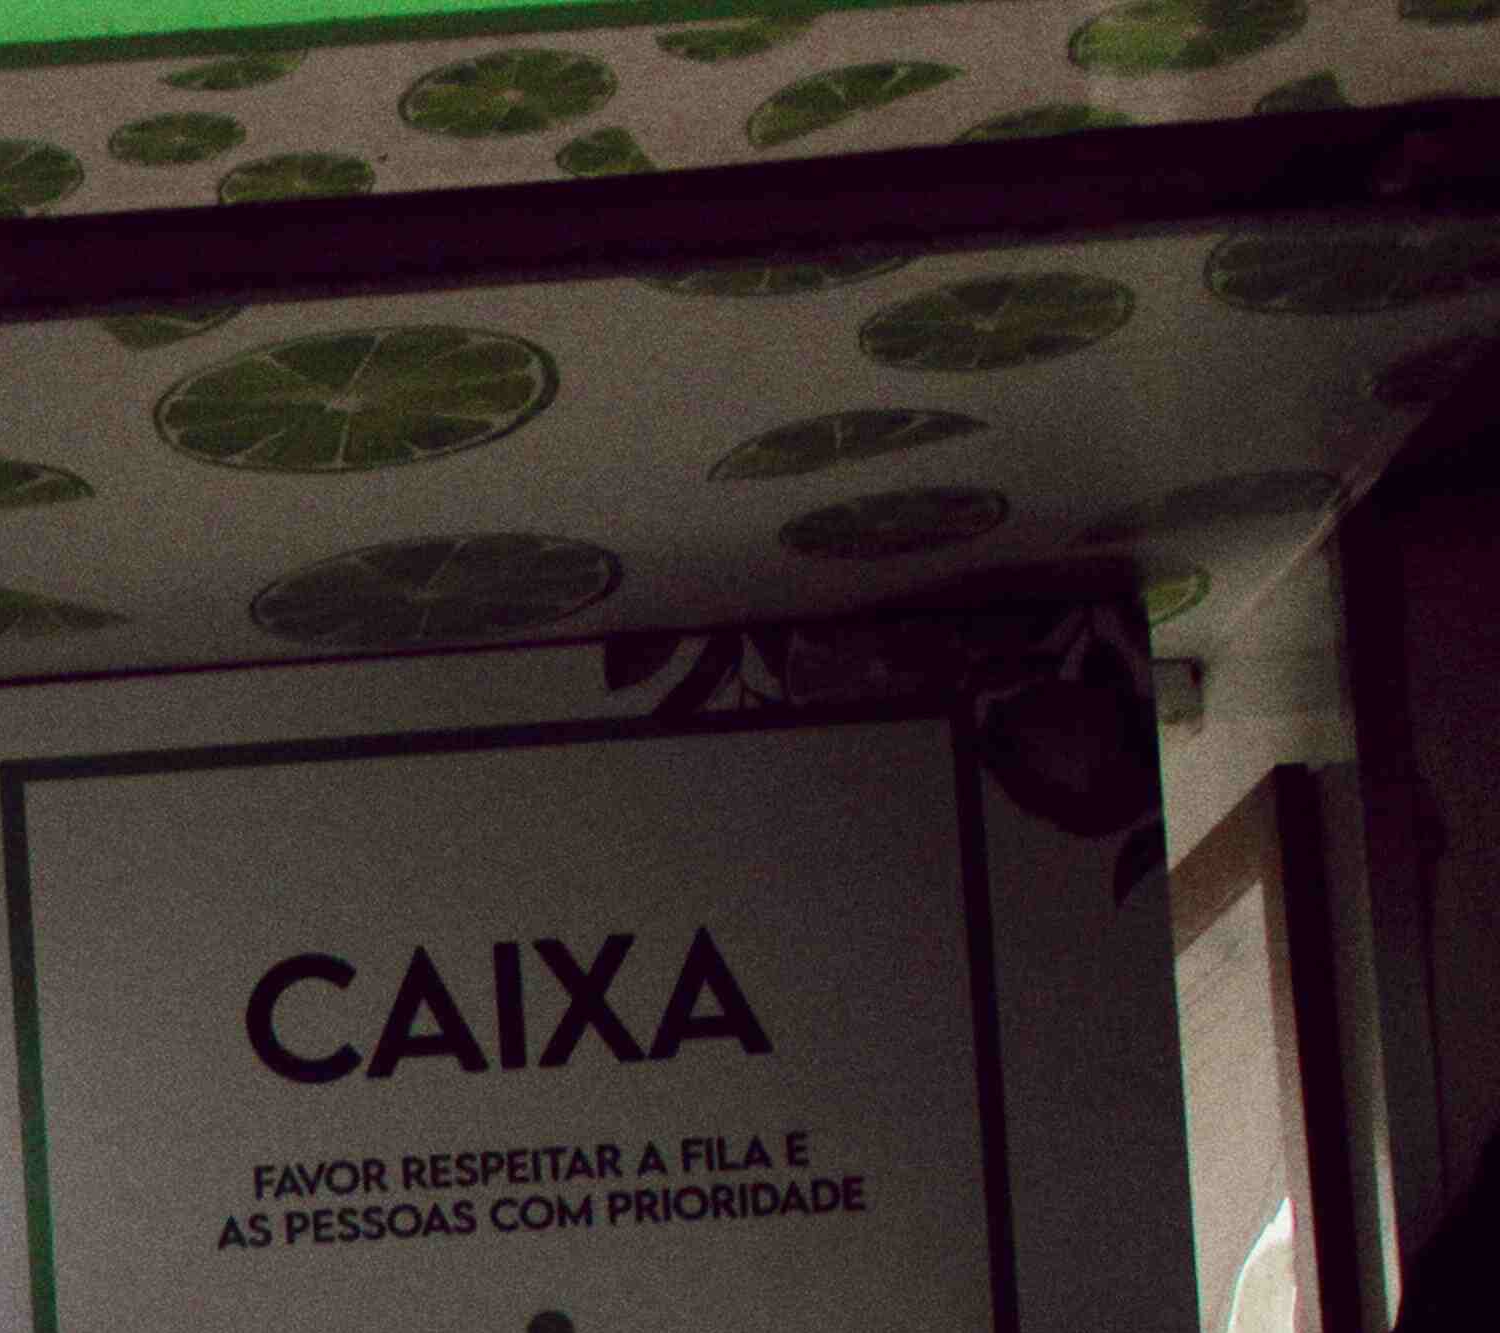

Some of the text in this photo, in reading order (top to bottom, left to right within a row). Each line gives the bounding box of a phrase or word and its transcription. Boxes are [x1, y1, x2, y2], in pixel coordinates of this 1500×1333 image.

[244, 925, 773, 1084] CAIXA
[252, 1130, 809, 1201] FAVOR RESPEITAR A FILA E
[216, 1176, 866, 1252] AS PESSOAS COM PRIORIDADE
